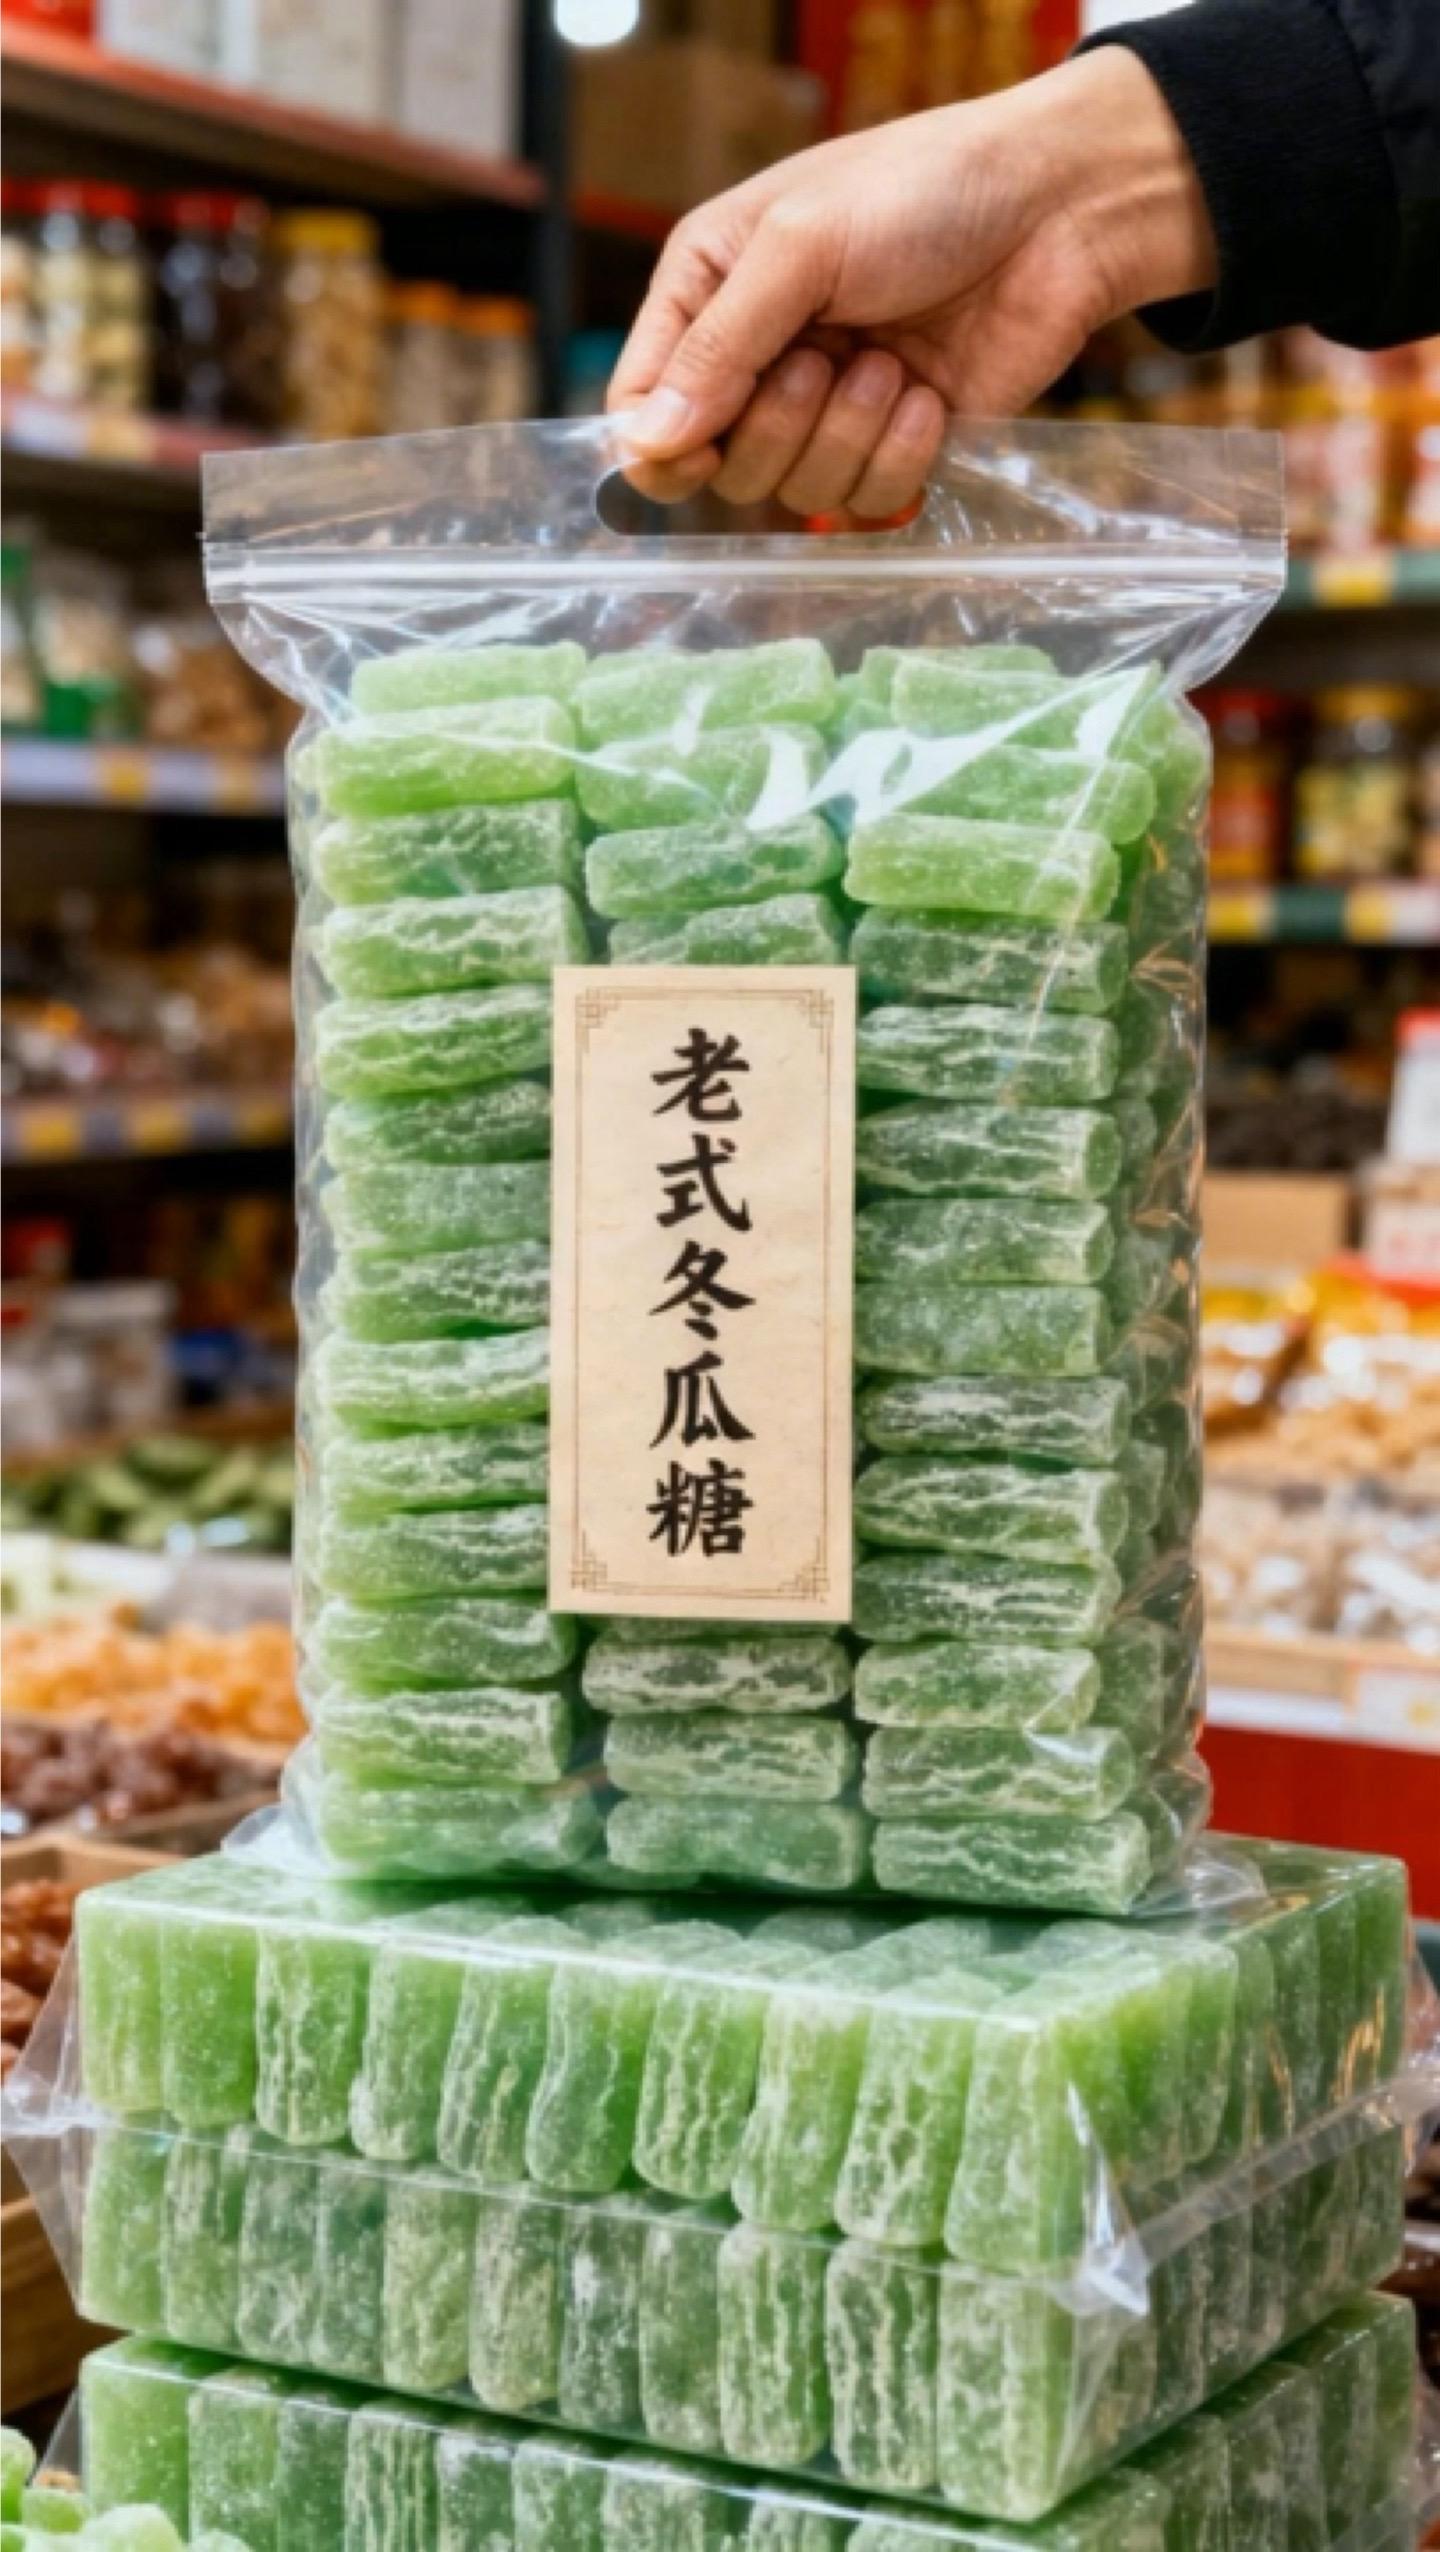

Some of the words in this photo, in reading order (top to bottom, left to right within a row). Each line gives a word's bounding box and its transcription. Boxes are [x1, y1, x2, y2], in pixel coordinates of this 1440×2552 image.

[647, 1027, 756, 1557] 老式冬瓜糖
